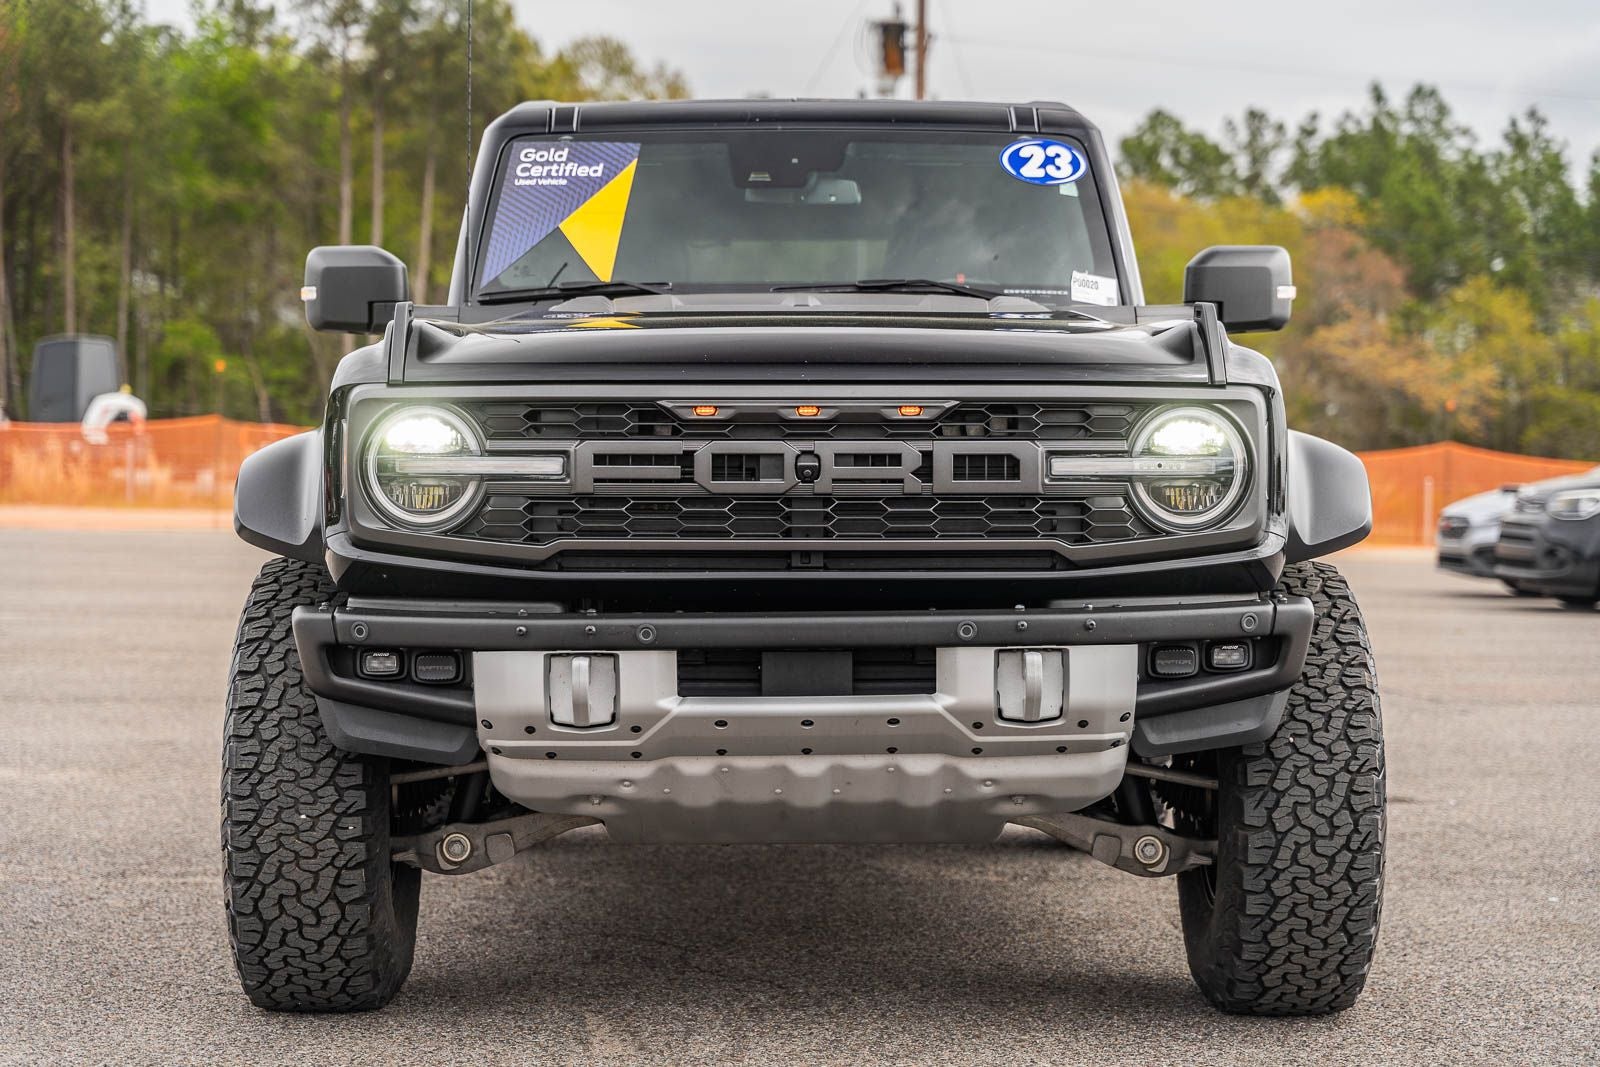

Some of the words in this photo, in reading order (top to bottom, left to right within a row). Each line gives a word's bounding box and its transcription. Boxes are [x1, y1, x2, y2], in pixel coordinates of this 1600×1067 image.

[519, 147, 569, 162] Gold
[1018, 145, 1073, 179] 23
[515, 163, 604, 177] Certified
[514, 178, 537, 186] Used
[537, 178, 568, 186] Vehicle
[571, 440, 1044, 495] FORD
